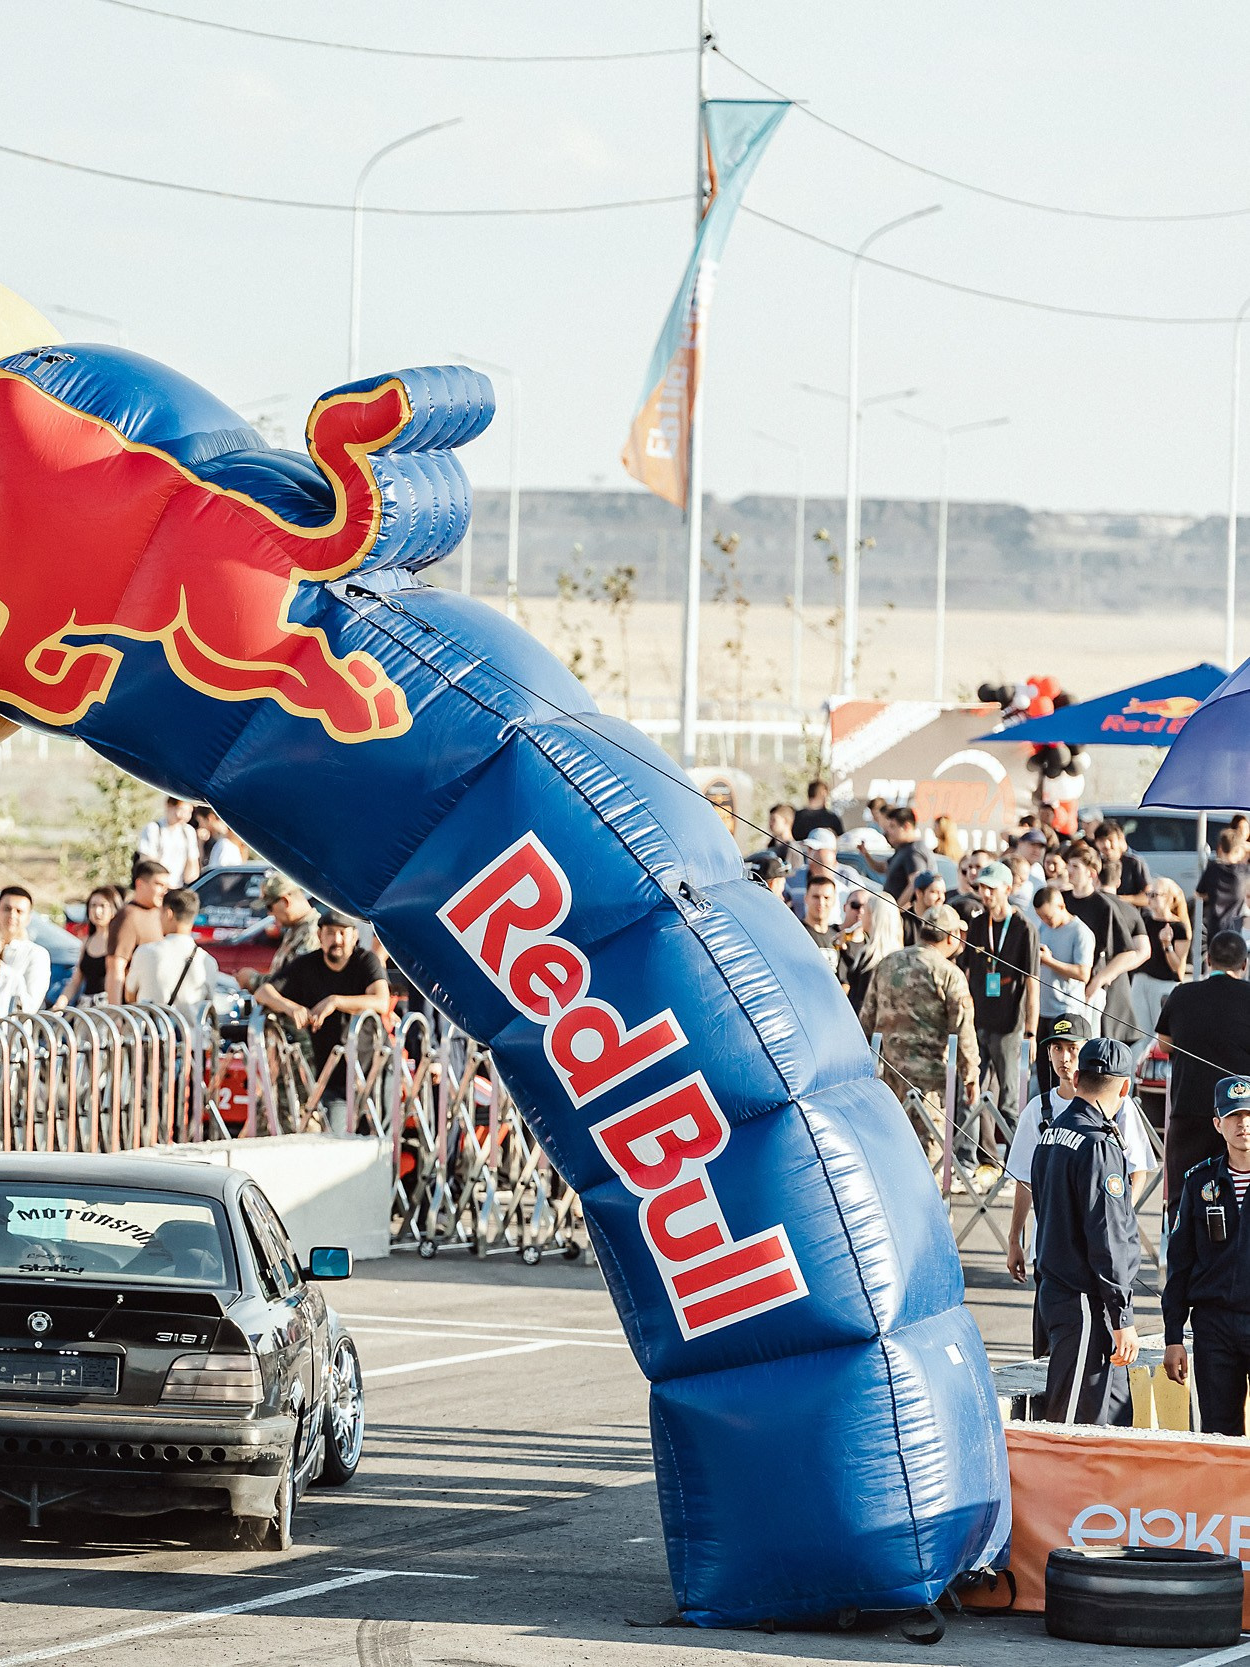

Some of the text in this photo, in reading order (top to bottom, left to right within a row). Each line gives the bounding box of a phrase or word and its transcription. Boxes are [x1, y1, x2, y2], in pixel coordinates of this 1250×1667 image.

[1101, 714, 1167, 733] Red
[438, 832, 807, 1338] Red Bull
[17, 1207, 170, 1261] MOTORSPO
